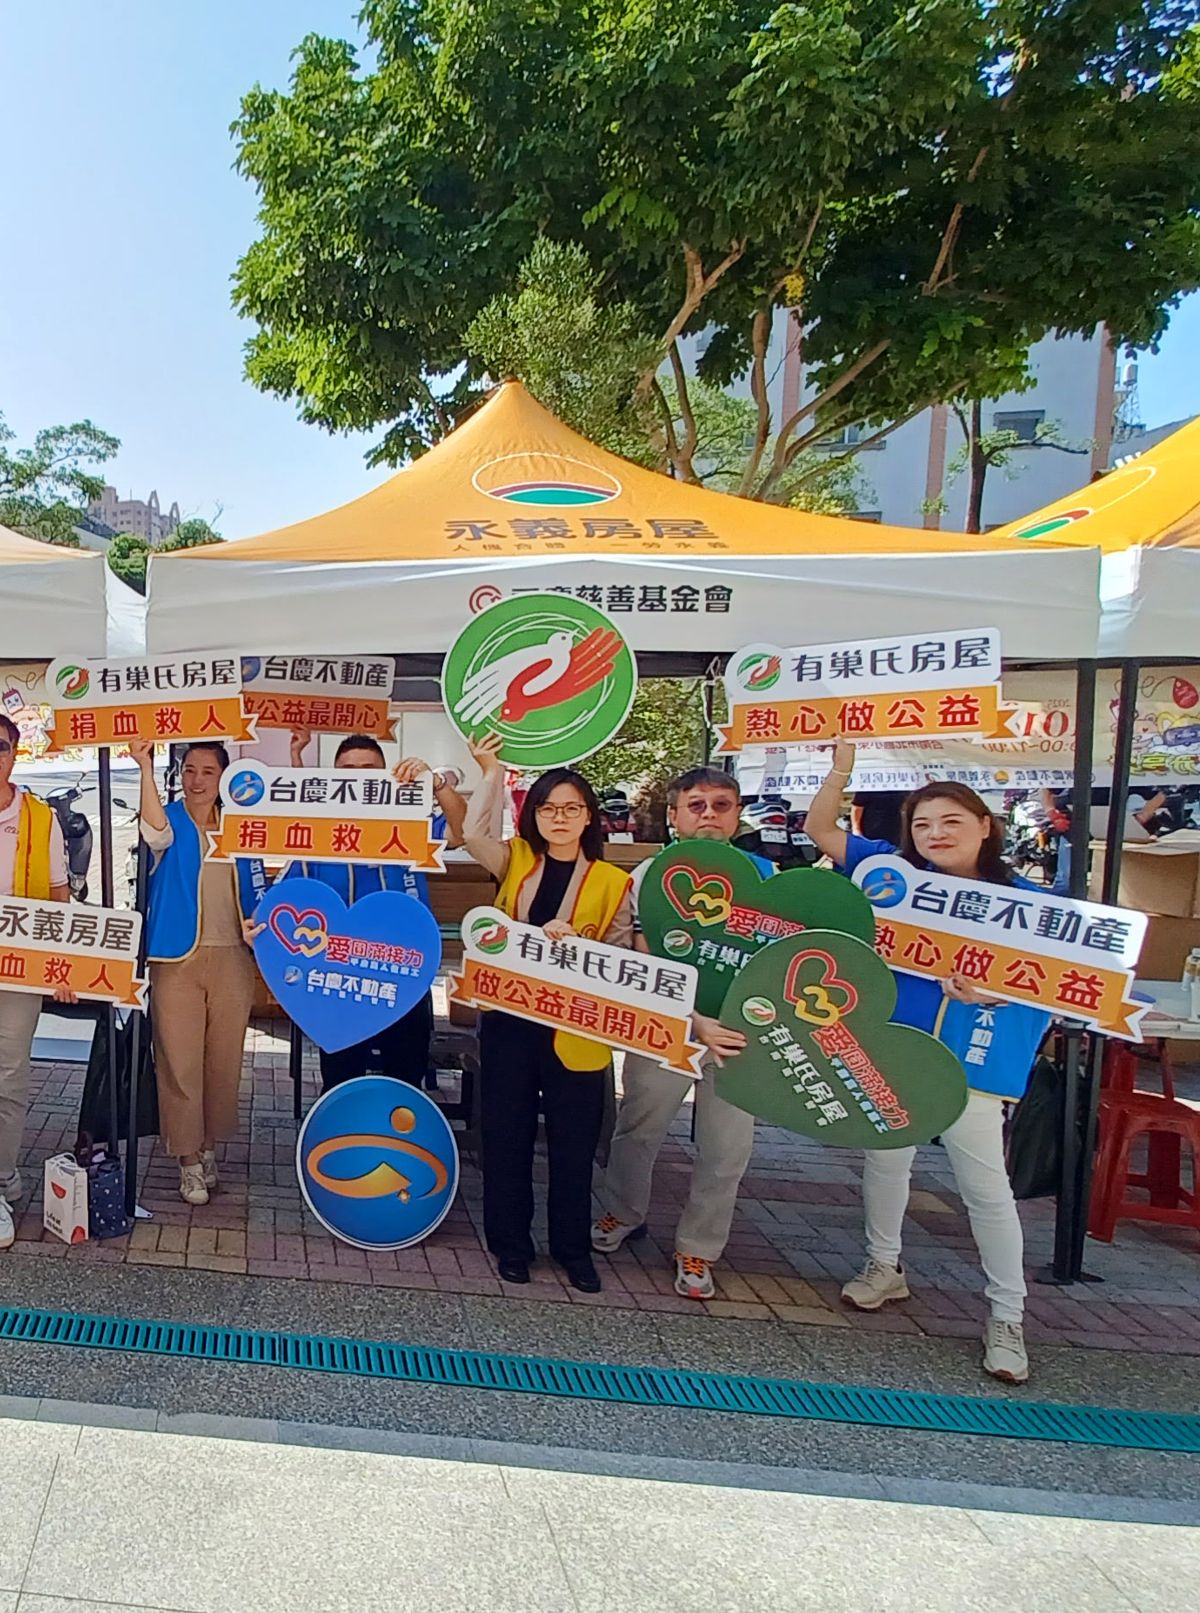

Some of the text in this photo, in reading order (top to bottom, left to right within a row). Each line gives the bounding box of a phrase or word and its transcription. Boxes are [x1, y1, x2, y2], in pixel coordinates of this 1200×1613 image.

[444, 517, 719, 541] 永義房屋
[511, 584, 733, 613] 慈善基金會
[96, 658, 238, 694] 有巢氏房屋
[263, 654, 390, 689] 台慶不動產
[790, 636, 992, 682] 有巢氏房屋
[69, 704, 227, 740] 捐血救人
[745, 693, 980, 739] 熱心做公益
[269, 776, 425, 806] 台慶不動產
[238, 819, 410, 855] 捐血救人
[910, 881, 1133, 955] 台慶不動產
[325, 934, 424, 968] 愛圓滿接力
[516, 931, 689, 1003] 有巢氏房屋
[874, 924, 1105, 1011] 熱心做公益
[307, 969, 398, 1001] 台慶不動產
[472, 967, 674, 1051] 做公益最開心
[767, 1023, 849, 1125] 有巢氏房屋
[809, 1020, 911, 1130] 愛圓滿接力
